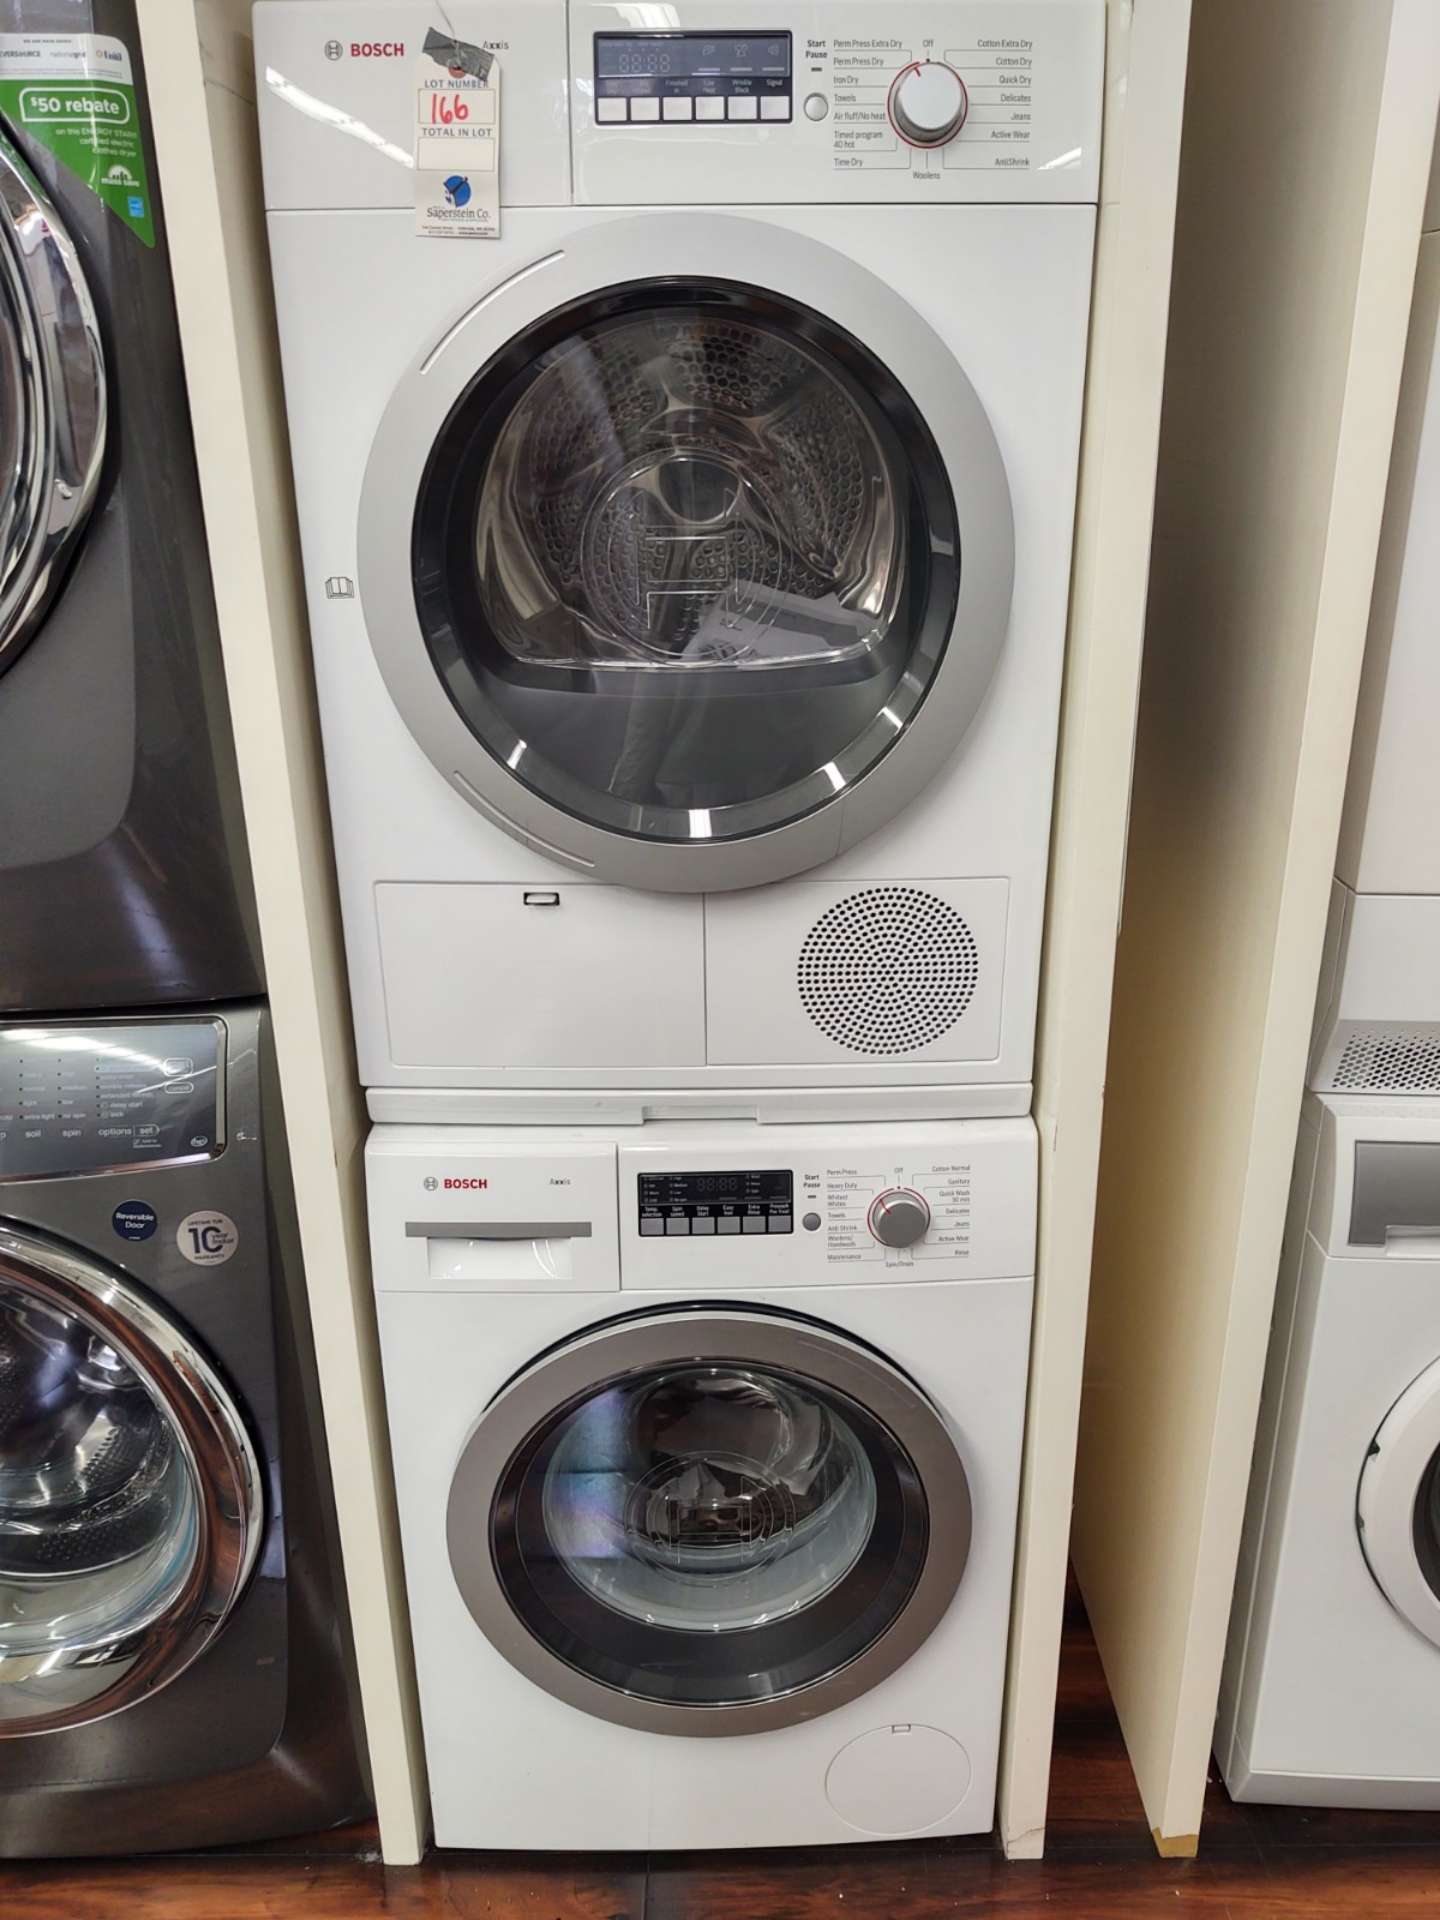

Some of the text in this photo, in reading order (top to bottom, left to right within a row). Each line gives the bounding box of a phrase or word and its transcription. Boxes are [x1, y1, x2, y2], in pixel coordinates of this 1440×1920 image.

[807, 40, 826, 48] Start
[834, 40, 902, 49] Perm Press Extra Dry
[978, 40, 1032, 49] Cotton Extra Dry
[350, 43, 404, 57] BOSCH
[806, 50, 828, 58] Pause
[834, 58, 884, 67] Perm Press Dry
[996, 58, 1032, 66] Cotton Dry
[424, 80, 488, 89] LOT NUMBER
[847, 76, 858, 85] Dry
[999, 76, 1032, 85] Quick Dry
[834, 94, 856, 102] Towels
[1000, 94, 1032, 102] Delicates
[30, 96, 120, 114] $50 rebate
[431, 94, 468, 124] 166
[834, 112, 842, 120] Air
[872, 112, 885, 120] heat
[1010, 112, 1031, 120] Jeans
[422, 128, 493, 137] TOTAL IN LOT
[834, 130, 882, 140] Timed program
[991, 130, 1030, 139] Active Wear
[834, 158, 862, 168] Time Dry
[913, 172, 940, 180] Woolens
[427, 208, 491, 220] Saperstein Co.
[25, 1129, 42, 1138] soil
[62, 1128, 82, 1139] spin
[98, 1126, 132, 1138] options
[444, 1178, 488, 1190] BOSCH
[844, 1182, 857, 1190] Duty
[939, 1190, 954, 1198] Quick
[116, 1212, 154, 1222] Reversible
[125, 1221, 145, 1230] Door
